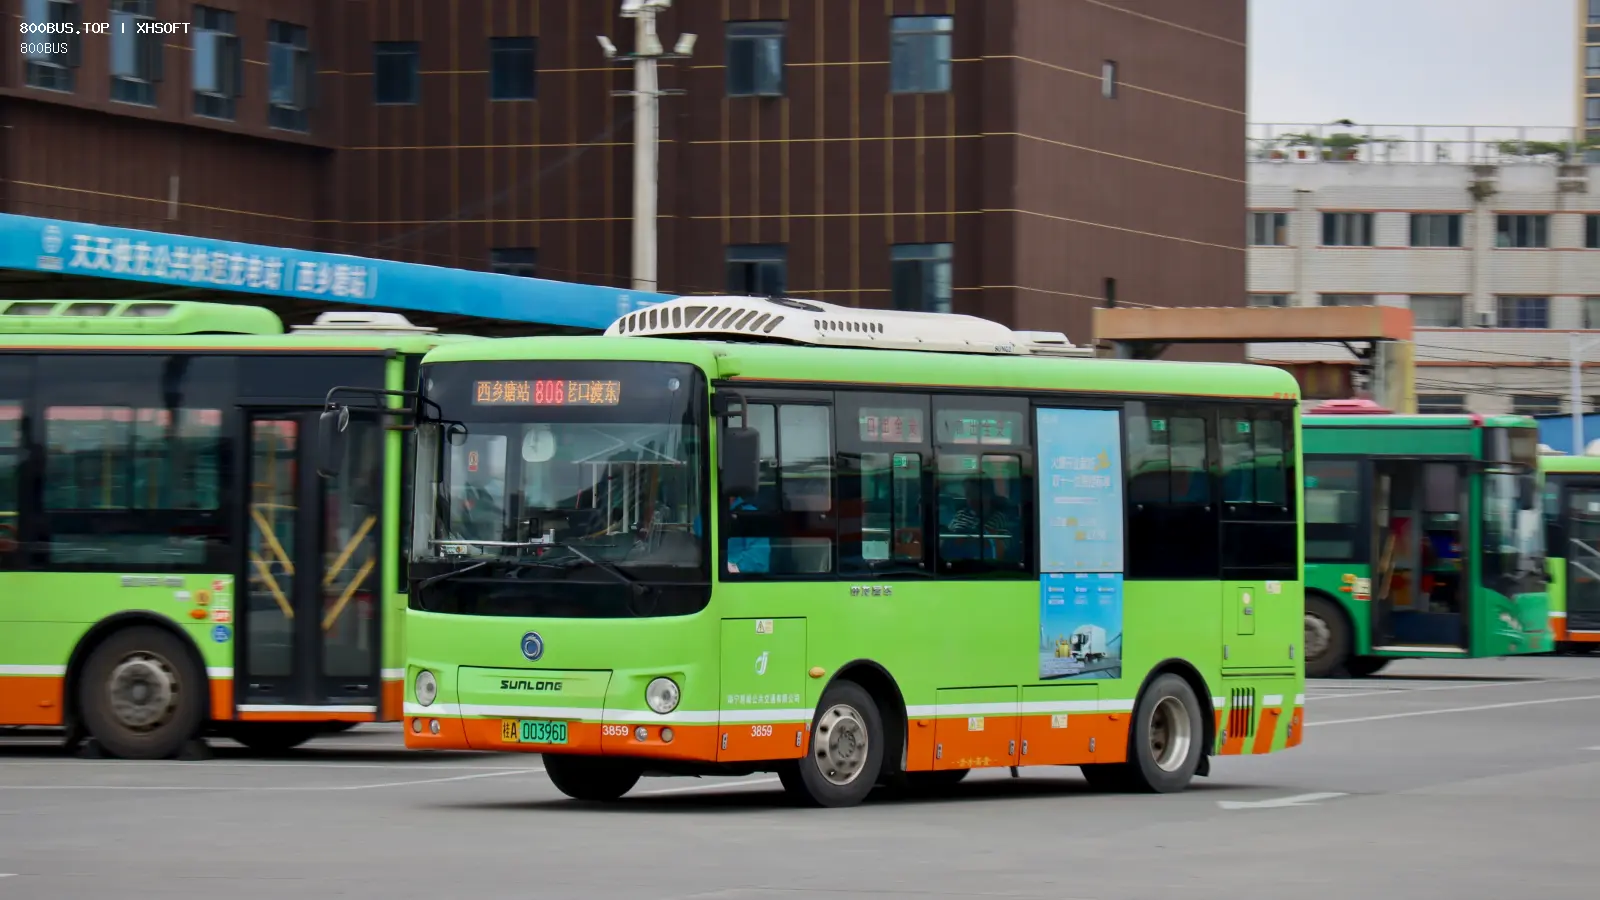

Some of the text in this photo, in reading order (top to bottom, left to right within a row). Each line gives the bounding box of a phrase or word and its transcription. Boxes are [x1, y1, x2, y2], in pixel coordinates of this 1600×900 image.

[477, 380, 531, 403] 西乡塘站
[535, 380, 564, 405] 806
[500, 680, 563, 691] SUNLONG
[503, 722, 567, 741] 桂A 00396D
[602, 725, 629, 737] 3859
[750, 724, 773, 738] 3859
